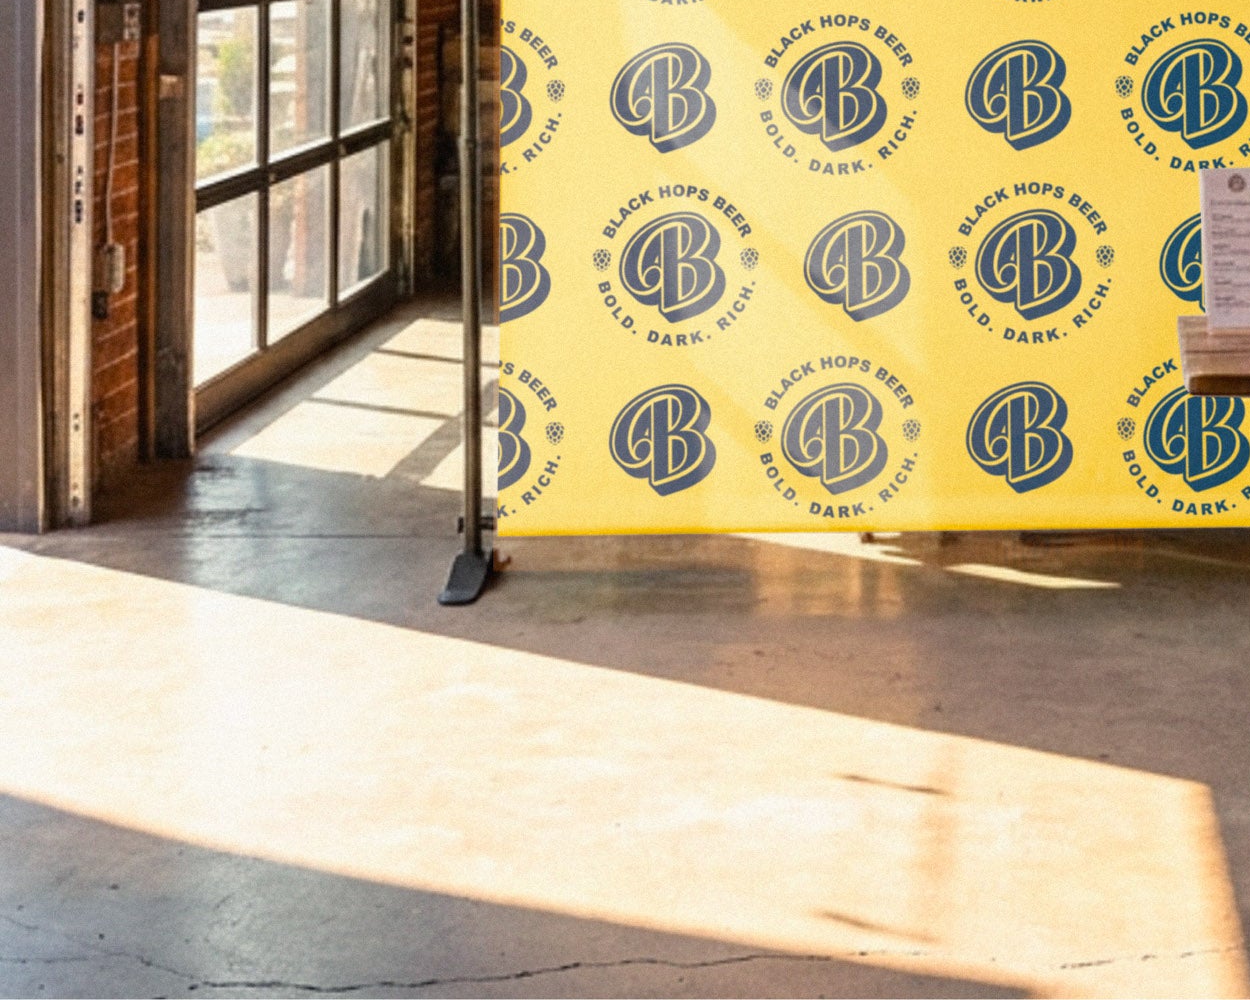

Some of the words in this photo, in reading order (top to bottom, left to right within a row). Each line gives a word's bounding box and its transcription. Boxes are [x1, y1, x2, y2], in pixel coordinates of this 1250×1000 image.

[520, 28, 558, 69] BEER
[765, 20, 815, 68] BLACK
[820, 14, 870, 31] HOPS
[874, 26, 912, 67] BEER
[1124, 17, 1175, 66] BLACK
[1180, 11, 1231, 29] HOPS
[523, 113, 561, 162] RICH.
[760, 110, 799, 162] BOLD.
[809, 159, 872, 174] DARK.
[878, 111, 917, 159] RICH.
[1121, 107, 1159, 161] BOLD.
[1170, 156, 1234, 172] DARK.
[603, 191, 653, 238] BLACK
[659, 185, 709, 201] HOPS
[713, 196, 751, 238] BEER
[958, 188, 1009, 236] BLACK
[1014, 182, 1064, 199] HOPS
[1068, 193, 1107, 235] BEER
[599, 281, 636, 334] BOLD.
[647, 330, 711, 346] DARK.
[717, 282, 755, 330] RICH.
[954, 278, 993, 331] BOLD.
[1003, 328, 1067, 344] DARK.
[1072, 279, 1111, 328] RICH.
[518, 370, 557, 411] BEER
[765, 362, 815, 409] BLACK
[821, 356, 871, 372] HOPS
[875, 367, 913, 408] BEER
[1127, 358, 1178, 407] BLACK
[521, 456, 560, 505] RICH.
[760, 453, 798, 505] BOLD.
[809, 502, 873, 518] DARK.
[879, 453, 917, 502] RICH.
[1123, 450, 1161, 504] BOLD.
[1172, 499, 1236, 515] DARK.
